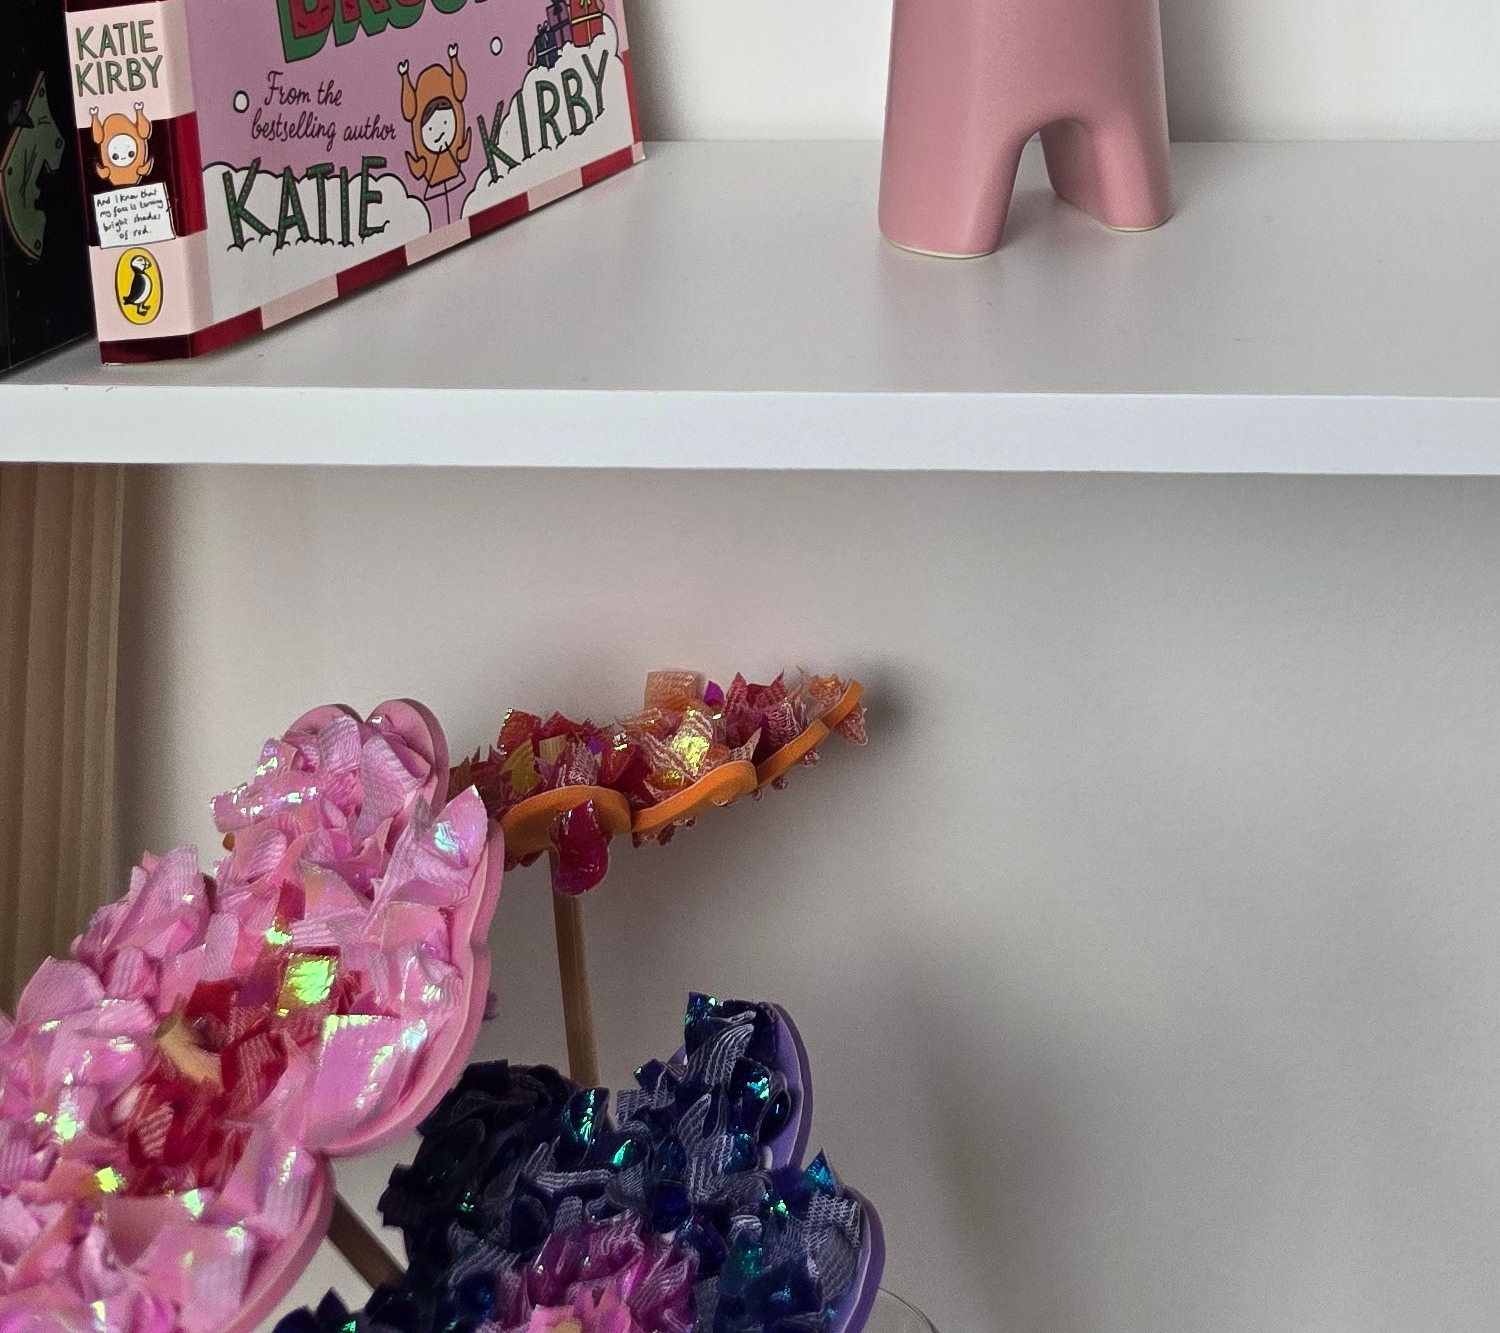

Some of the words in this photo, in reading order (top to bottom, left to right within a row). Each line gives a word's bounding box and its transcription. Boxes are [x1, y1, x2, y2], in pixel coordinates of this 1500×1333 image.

[75, 19, 159, 60] KATIE
[75, 54, 164, 97] KIRBY
[264, 70, 312, 106] From
[317, 79, 343, 107] the
[221, 156, 391, 247] KATIE
[477, 48, 610, 183] KIRBY
[251, 107, 337, 152] bestselling
[343, 114, 397, 142] author
[96, 194, 111, 207] And
[140, 188, 157, 199] that
[119, 229, 128, 241] of
